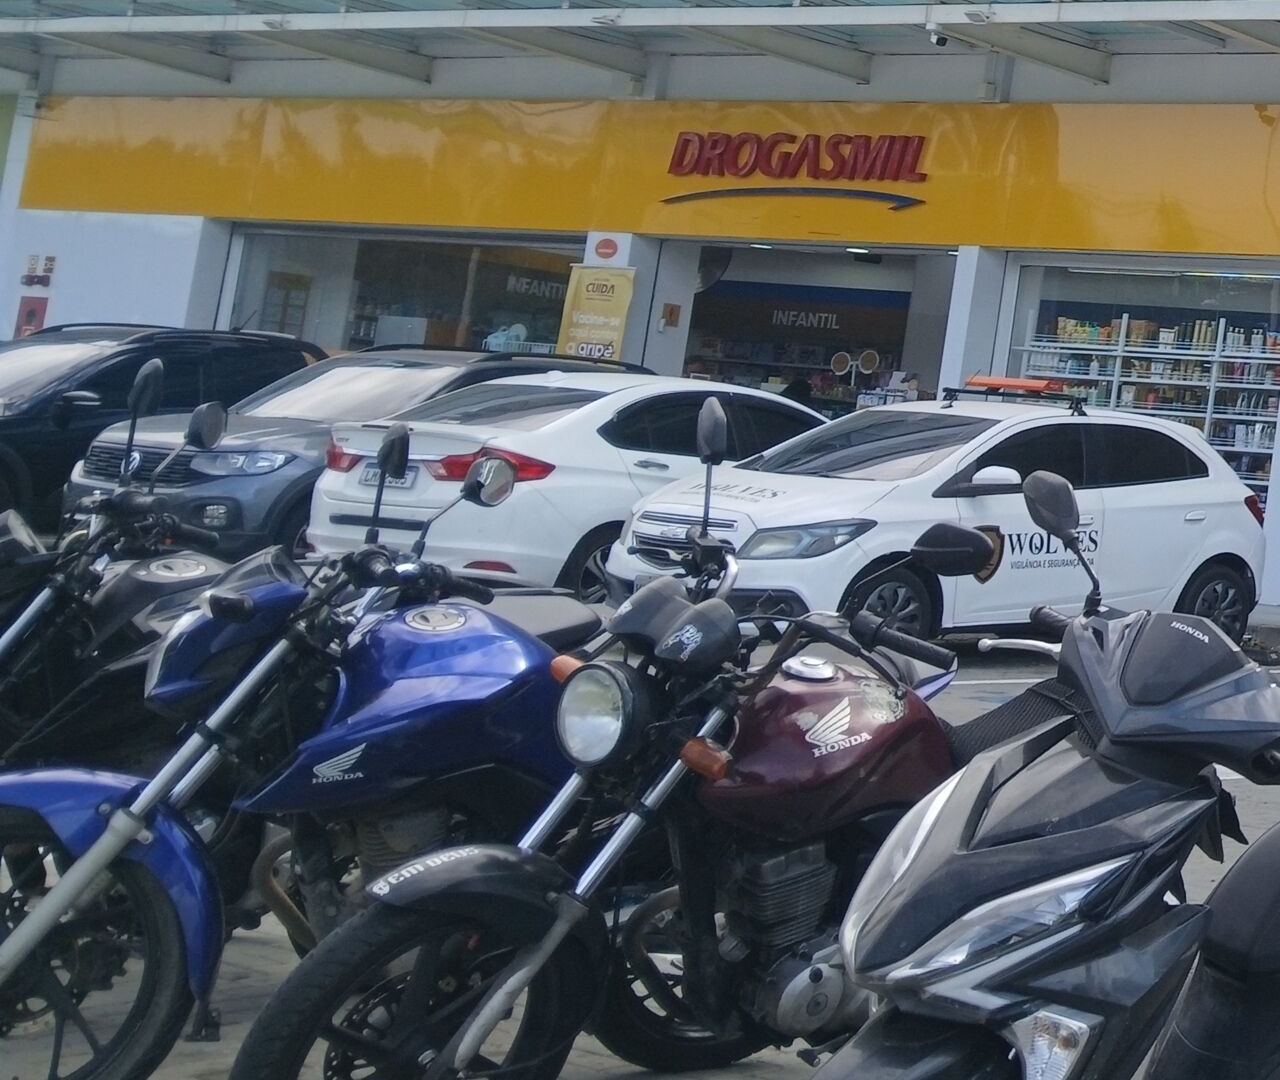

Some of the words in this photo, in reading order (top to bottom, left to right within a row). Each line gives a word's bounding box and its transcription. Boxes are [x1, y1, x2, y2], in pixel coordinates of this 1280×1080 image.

[667, 131, 928, 183] DROGASMIL
[585, 282, 616, 295] CUIDA
[772, 309, 840, 330] INFANTIL
[1170, 621, 1209, 644] HONDA
[811, 732, 873, 758] HONDA
[311, 771, 365, 785] HONDA
